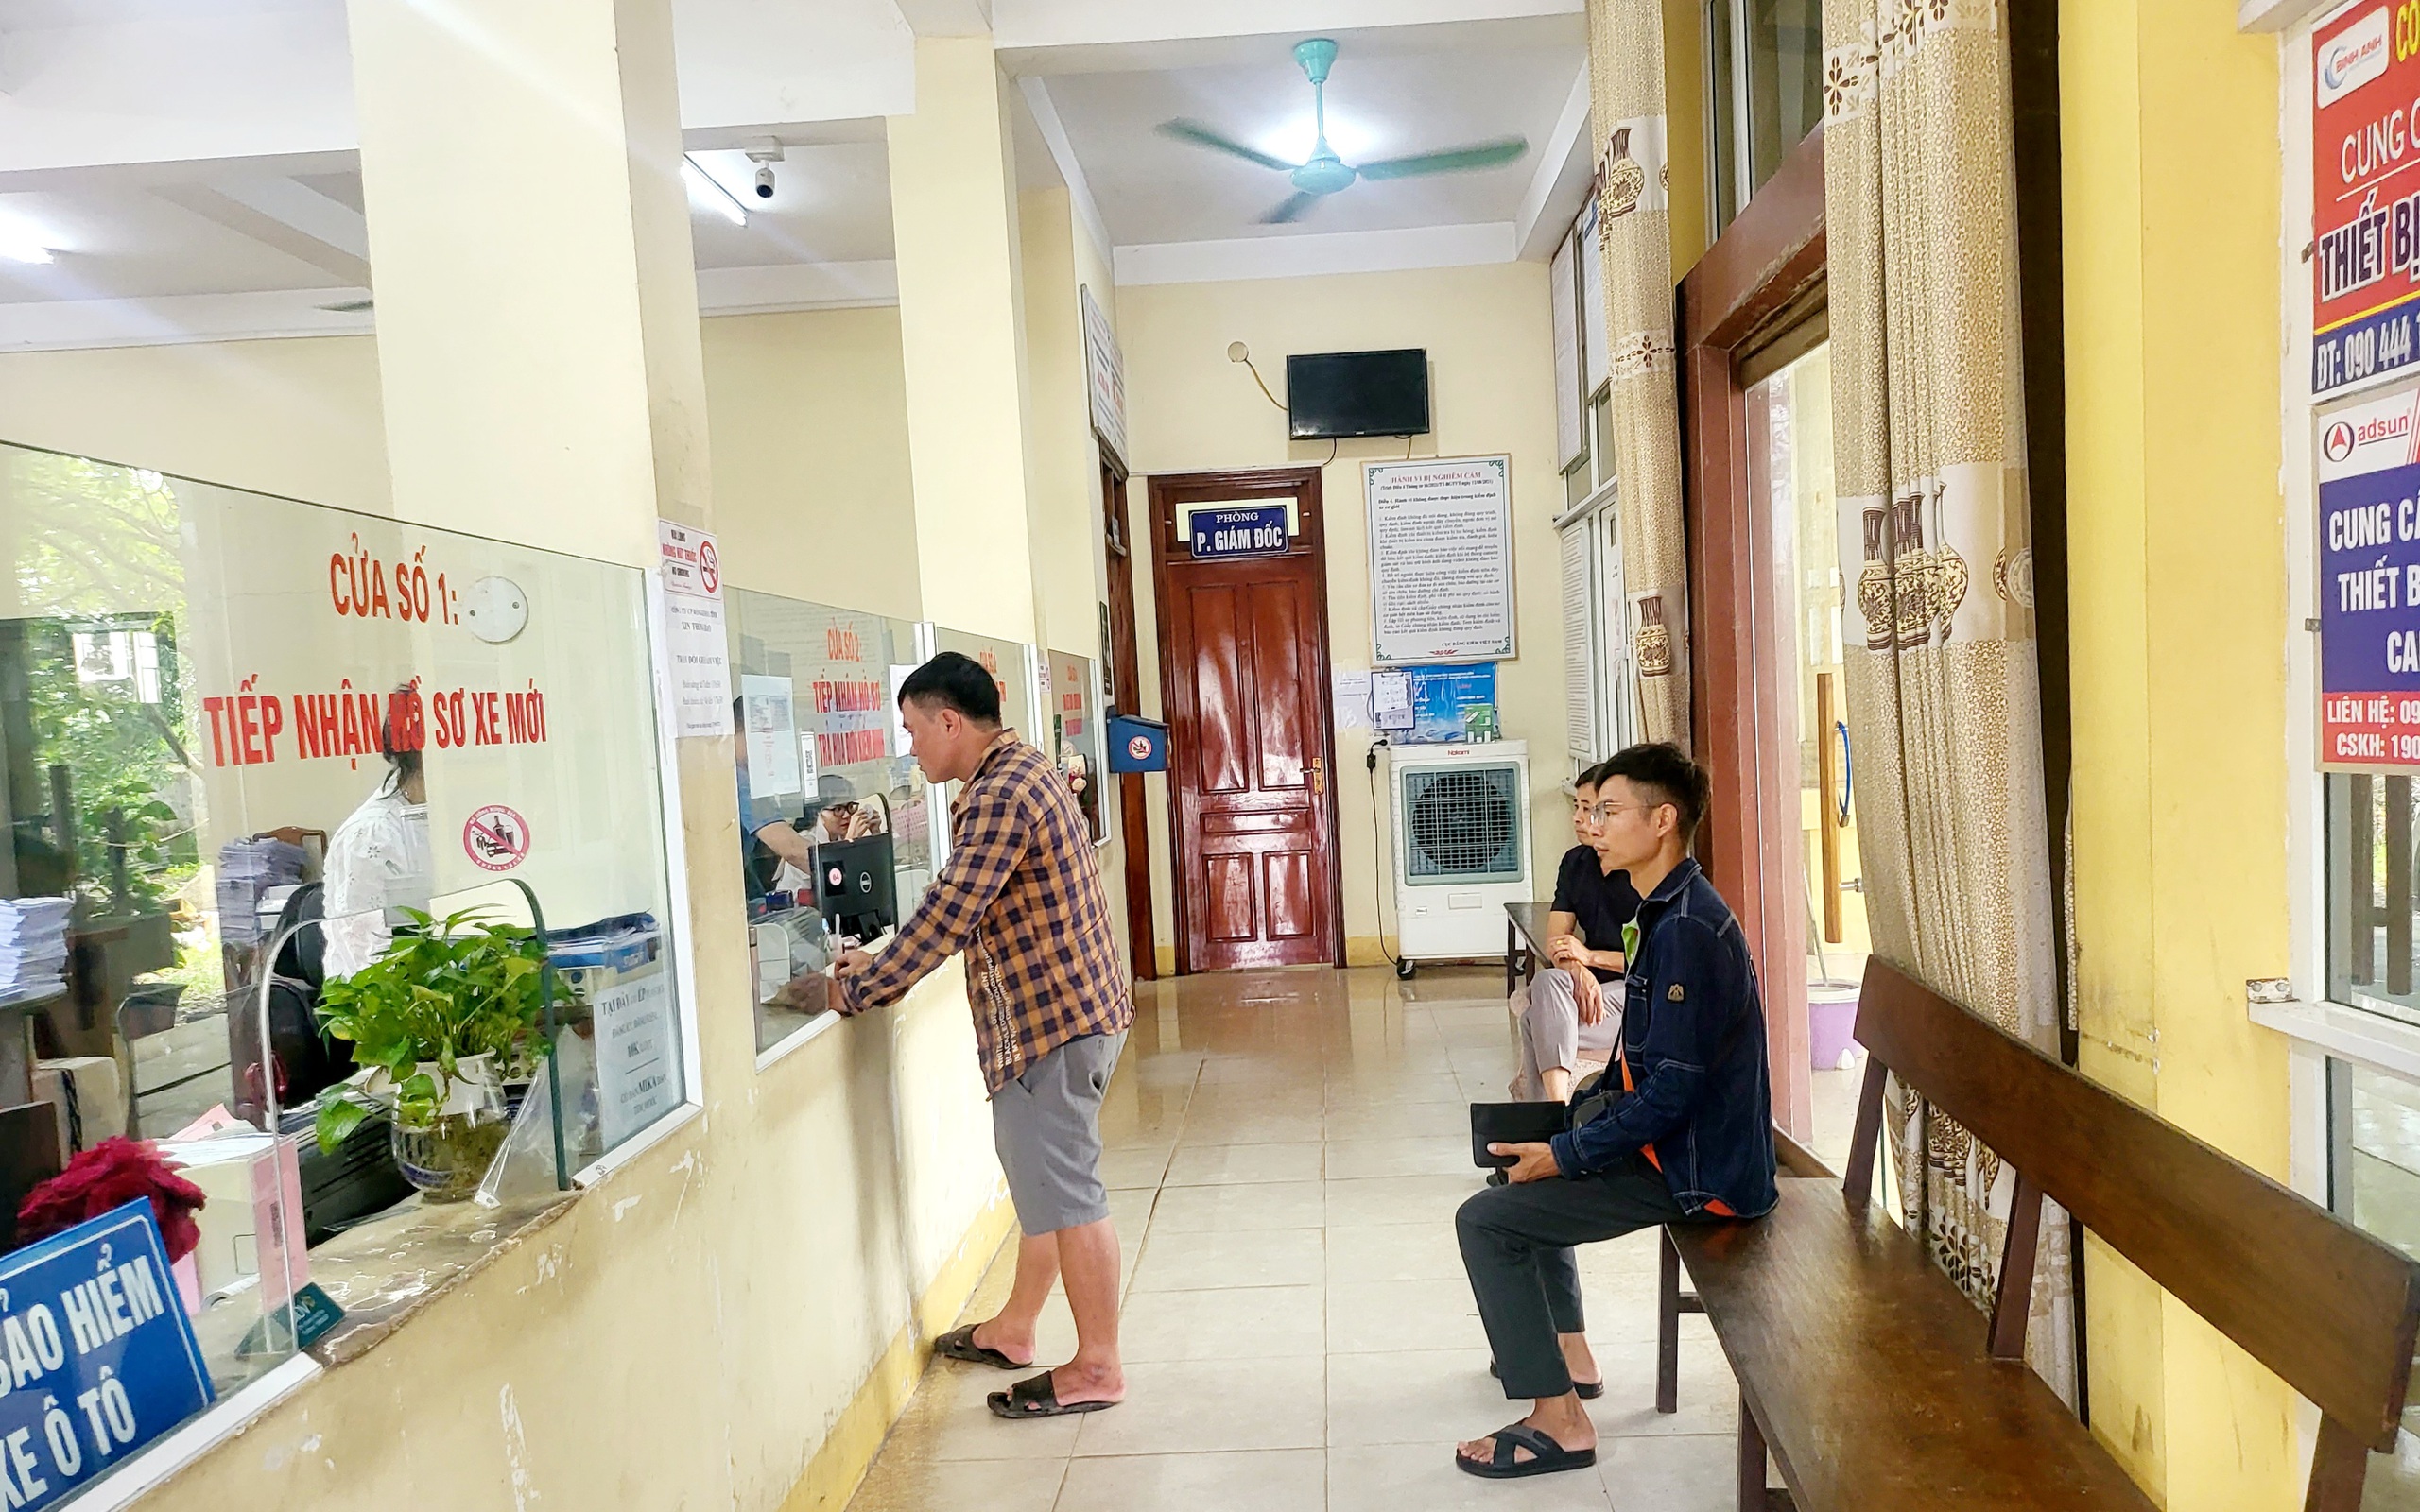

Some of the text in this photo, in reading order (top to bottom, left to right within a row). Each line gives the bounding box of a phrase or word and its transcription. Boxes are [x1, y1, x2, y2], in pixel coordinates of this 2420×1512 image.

[2341, 109, 2405, 184] CUNG
[2320, 189, 2388, 300] THIẾT
[2317, 339, 2342, 390] ĐT:
[2345, 327, 2375, 381] 090
[2378, 315, 2410, 370] 444
[2358, 414, 2408, 442] adsun
[1197, 520, 1283, 552] P. GIÁM ĐỐC
[1216, 511, 1259, 524] PHÒNG
[2328, 503, 2391, 552] CUNG
[331, 532, 459, 625] CỬA SỐ 1:
[2338, 555, 2400, 612] THIẾT
[827, 616, 844, 661] CỬA
[843, 621, 854, 662] SỐ
[813, 668, 832, 713] TIẾP
[2327, 696, 2363, 723] LIÊN
[2368, 695, 2395, 729] HỆ:
[203, 674, 547, 771] TIẾP NHẬN HỒ SƠ XE MỚI
[2336, 733, 2385, 757] CSKH:
[60, 1243, 164, 1355] HIỂM
[44, 1394, 81, 1476] Ô
[77, 1366, 136, 1456] TÔ
